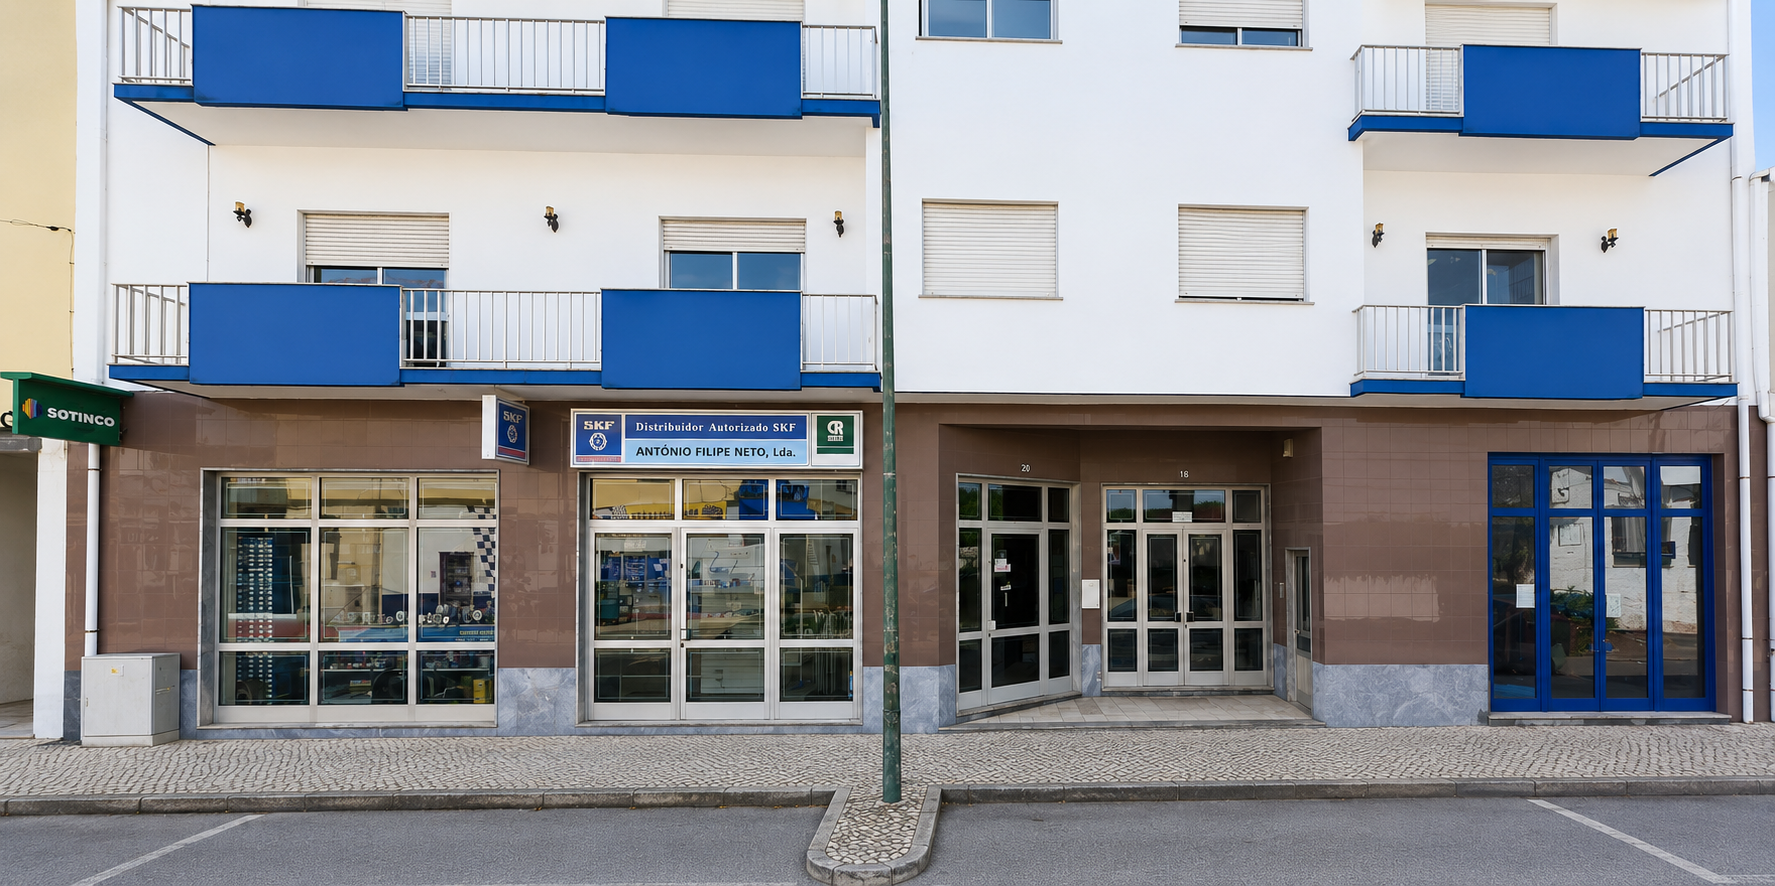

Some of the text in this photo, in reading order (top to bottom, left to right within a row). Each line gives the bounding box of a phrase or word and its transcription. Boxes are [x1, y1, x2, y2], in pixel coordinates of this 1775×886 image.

[47, 407, 115, 427] SOTINCO
[503, 410, 523, 424] SKF
[583, 420, 615, 430] SKF
[635, 422, 797, 432] Distribuidor Autorizado SKF
[635, 443, 796, 459] ANTÓNIO FILIPE NETO, Lda.
[1021, 463, 1031, 472] 20
[1180, 470, 1189, 478] 18
